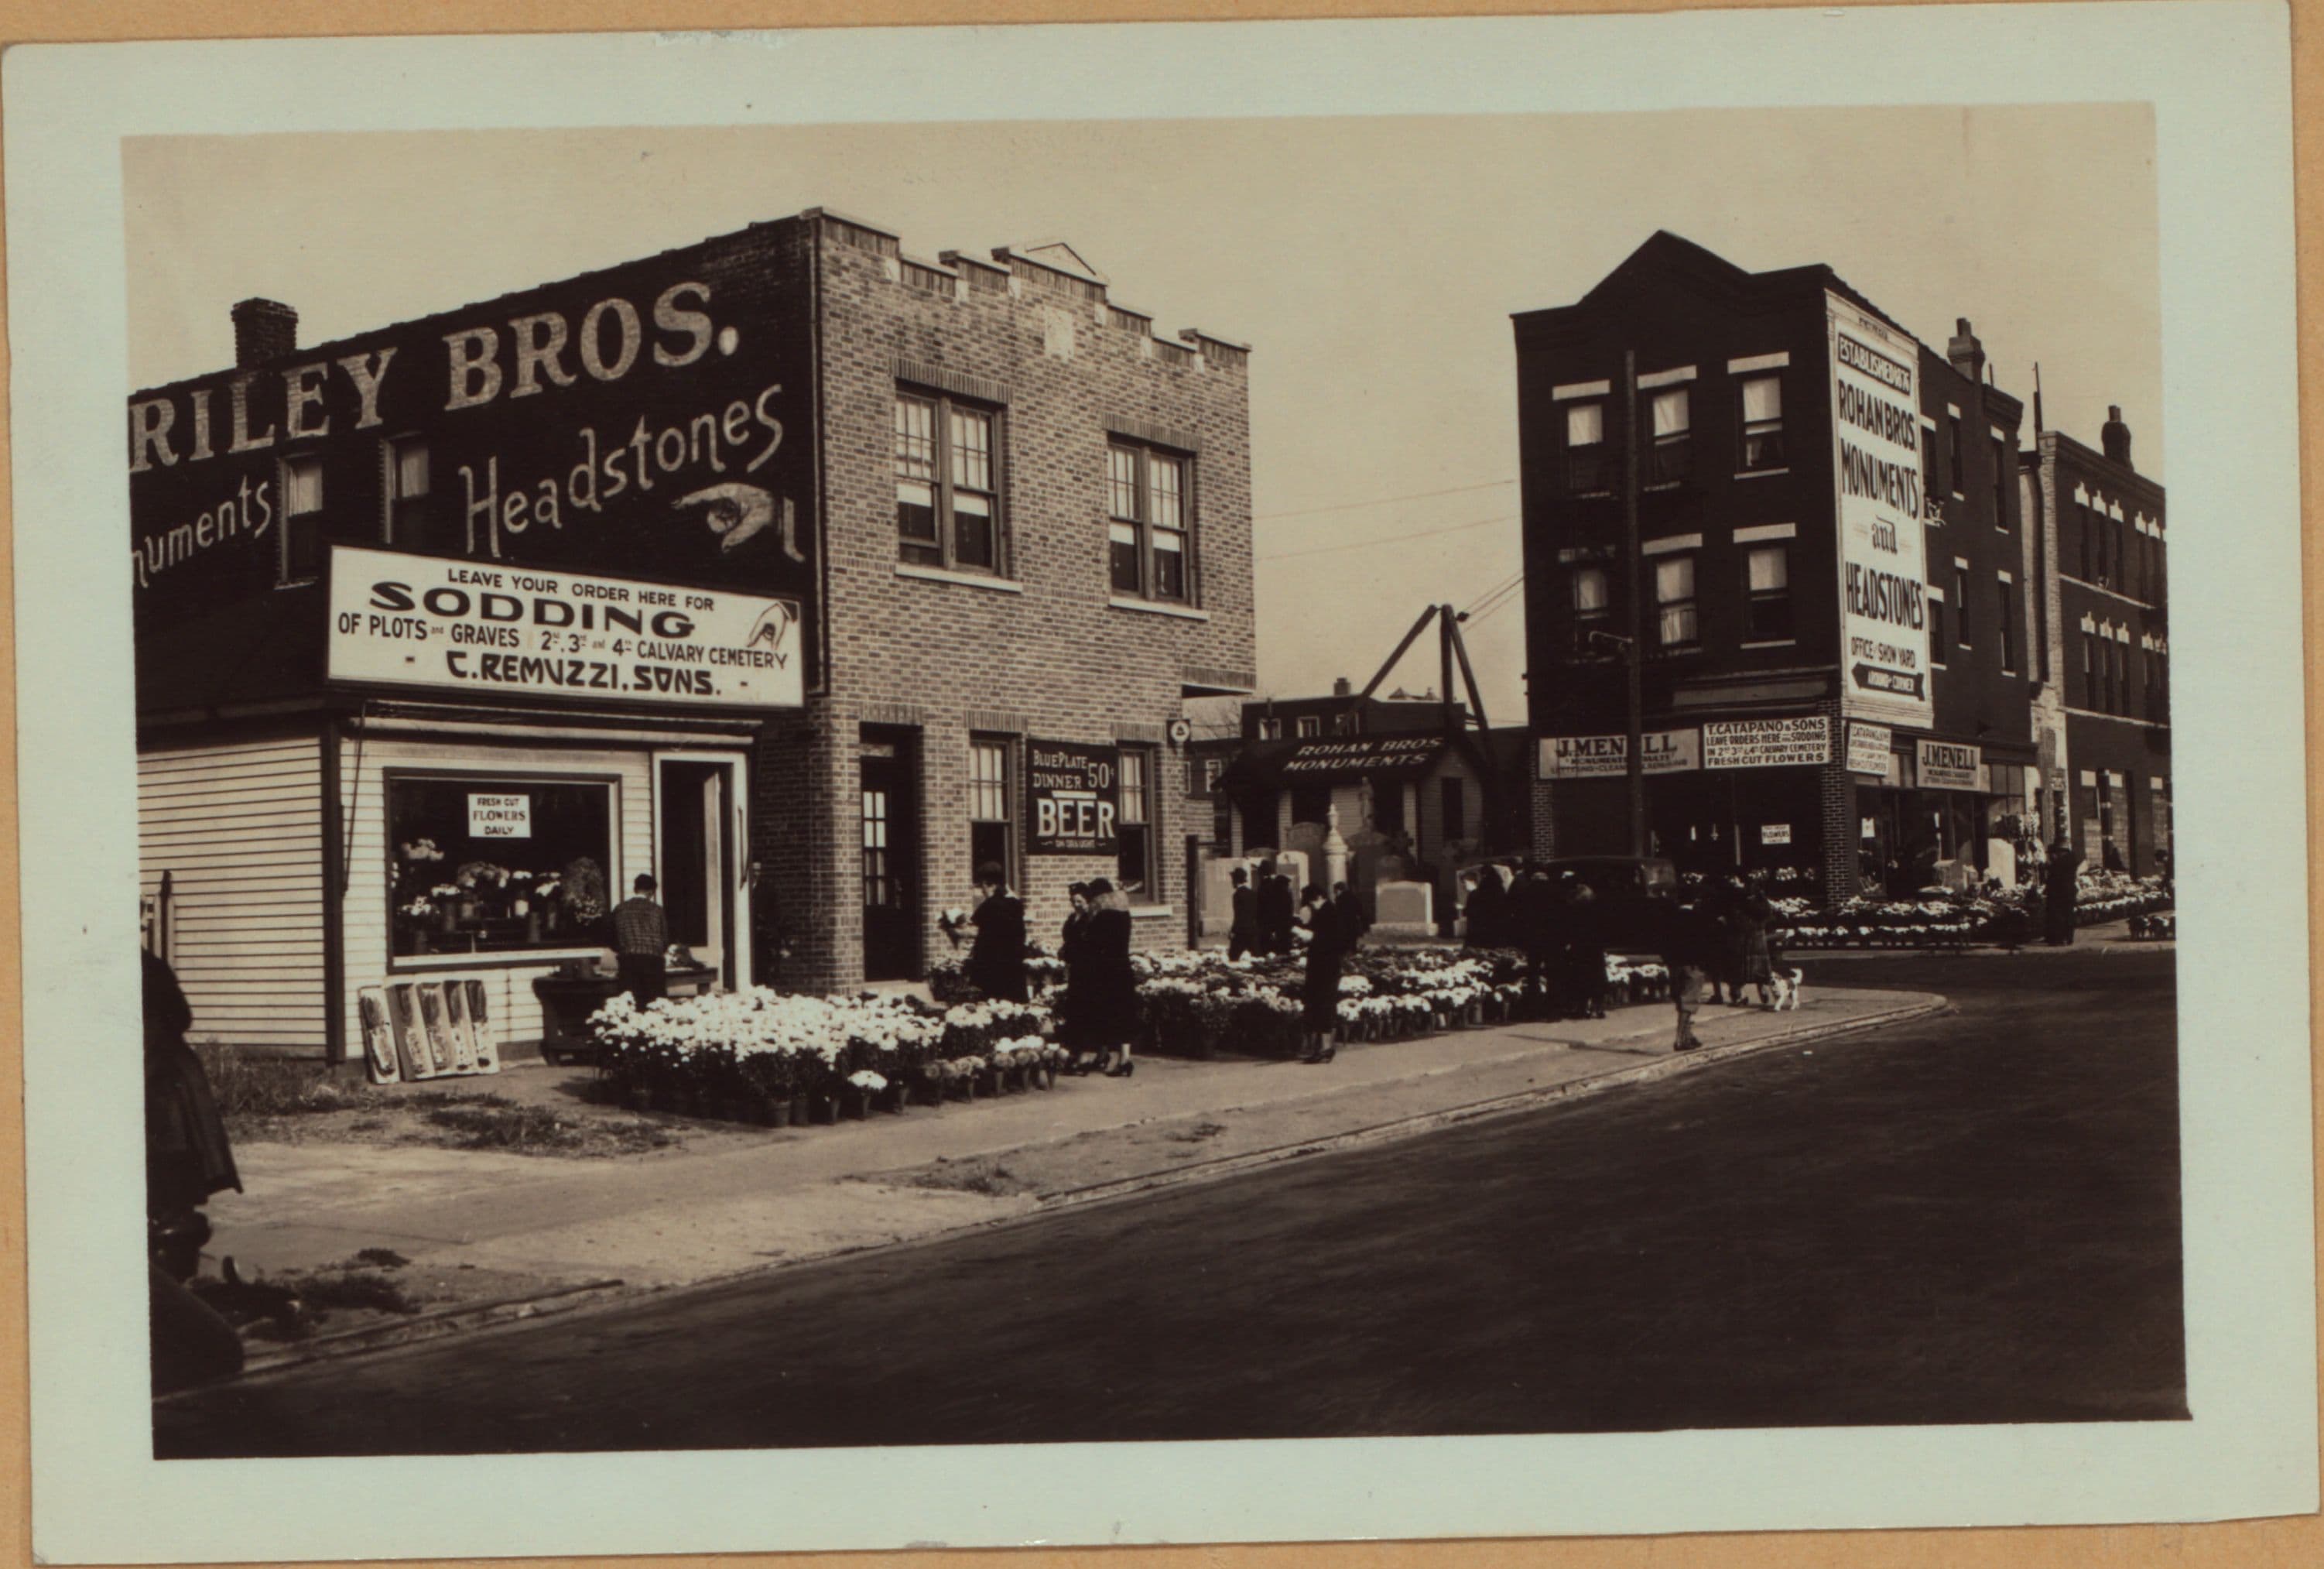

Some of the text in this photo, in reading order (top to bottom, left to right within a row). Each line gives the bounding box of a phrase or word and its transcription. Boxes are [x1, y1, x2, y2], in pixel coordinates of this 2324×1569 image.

[128, 282, 739, 474] RILEY BROS.
[1838, 380, 1917, 452] ROHAN BROS.
[459, 384, 782, 558] Headstones
[1840, 438, 1918, 520] MONUMENTS
[1871, 515, 1898, 555] and
[447, 568, 714, 611] LEAVE YOUR ORDER HERE FOR
[1846, 561, 1923, 631] HEADSTONES
[369, 581, 696, 639] SODDING
[338, 612, 361, 635] OF
[369, 615, 427, 641] PLOTS
[450, 623, 520, 647] GRAVES
[637, 640, 704, 663] CALVARY
[709, 647, 788, 670] CEMETERY
[1295, 737, 1443, 756] ROHAN BROS
[1556, 735, 1677, 757] J.MENLL
[1706, 721, 1783, 735] T.CATAPANO
[1792, 718, 1826, 731] SONS
[1282, 752, 1429, 772] MONUMENTS
[1708, 752, 1825, 766] FRESH CUT FLOWERS
[1033, 773, 1082, 789] DINNER
[473, 810, 526, 821] FLOWERS
[504, 797, 520, 807] CUT
[1037, 798, 1114, 838] BEER
[484, 824, 514, 835] DAILY
